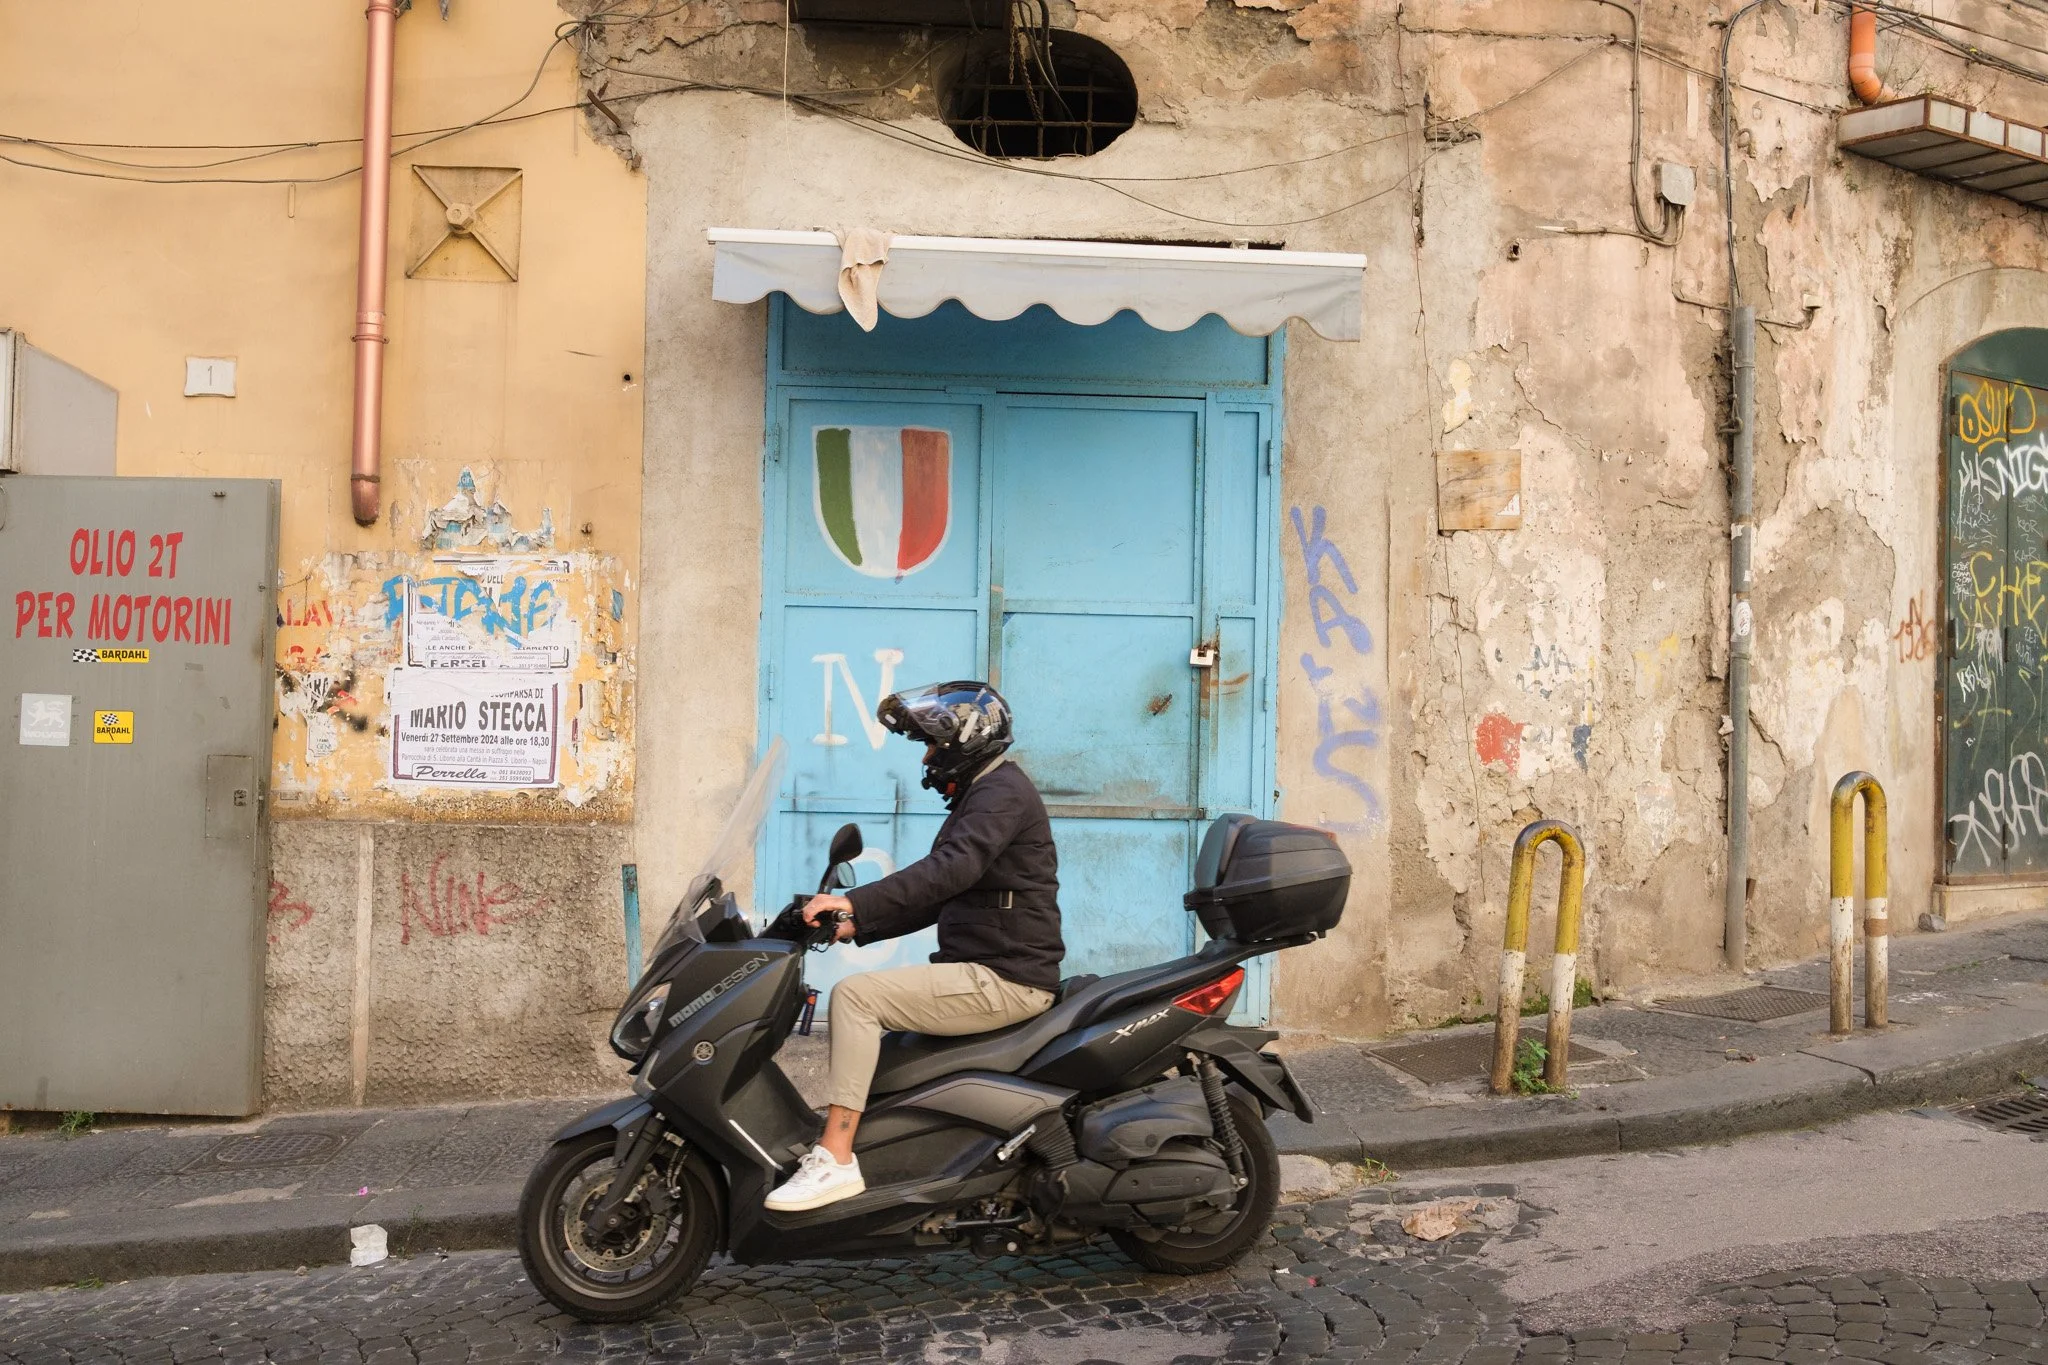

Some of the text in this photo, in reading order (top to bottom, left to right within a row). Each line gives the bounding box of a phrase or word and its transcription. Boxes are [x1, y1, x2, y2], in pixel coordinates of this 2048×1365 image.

[206, 365, 213, 386] 1
[70, 528, 183, 579] OLIO 2T
[15, 591, 231, 646] PER MOTORINI
[101, 650, 148, 661] BARDAHL
[535, 688, 544, 699] DI
[410, 700, 547, 732] MARIO STECCA
[96, 726, 131, 735] BARDAHL
[430, 732, 439, 743] 27
[441, 733, 479, 744] Settembre
[480, 734, 499, 745] 2024
[500, 735, 514, 746] alle
[515, 738, 528, 746] ore
[415, 765, 488, 779] Perrella
